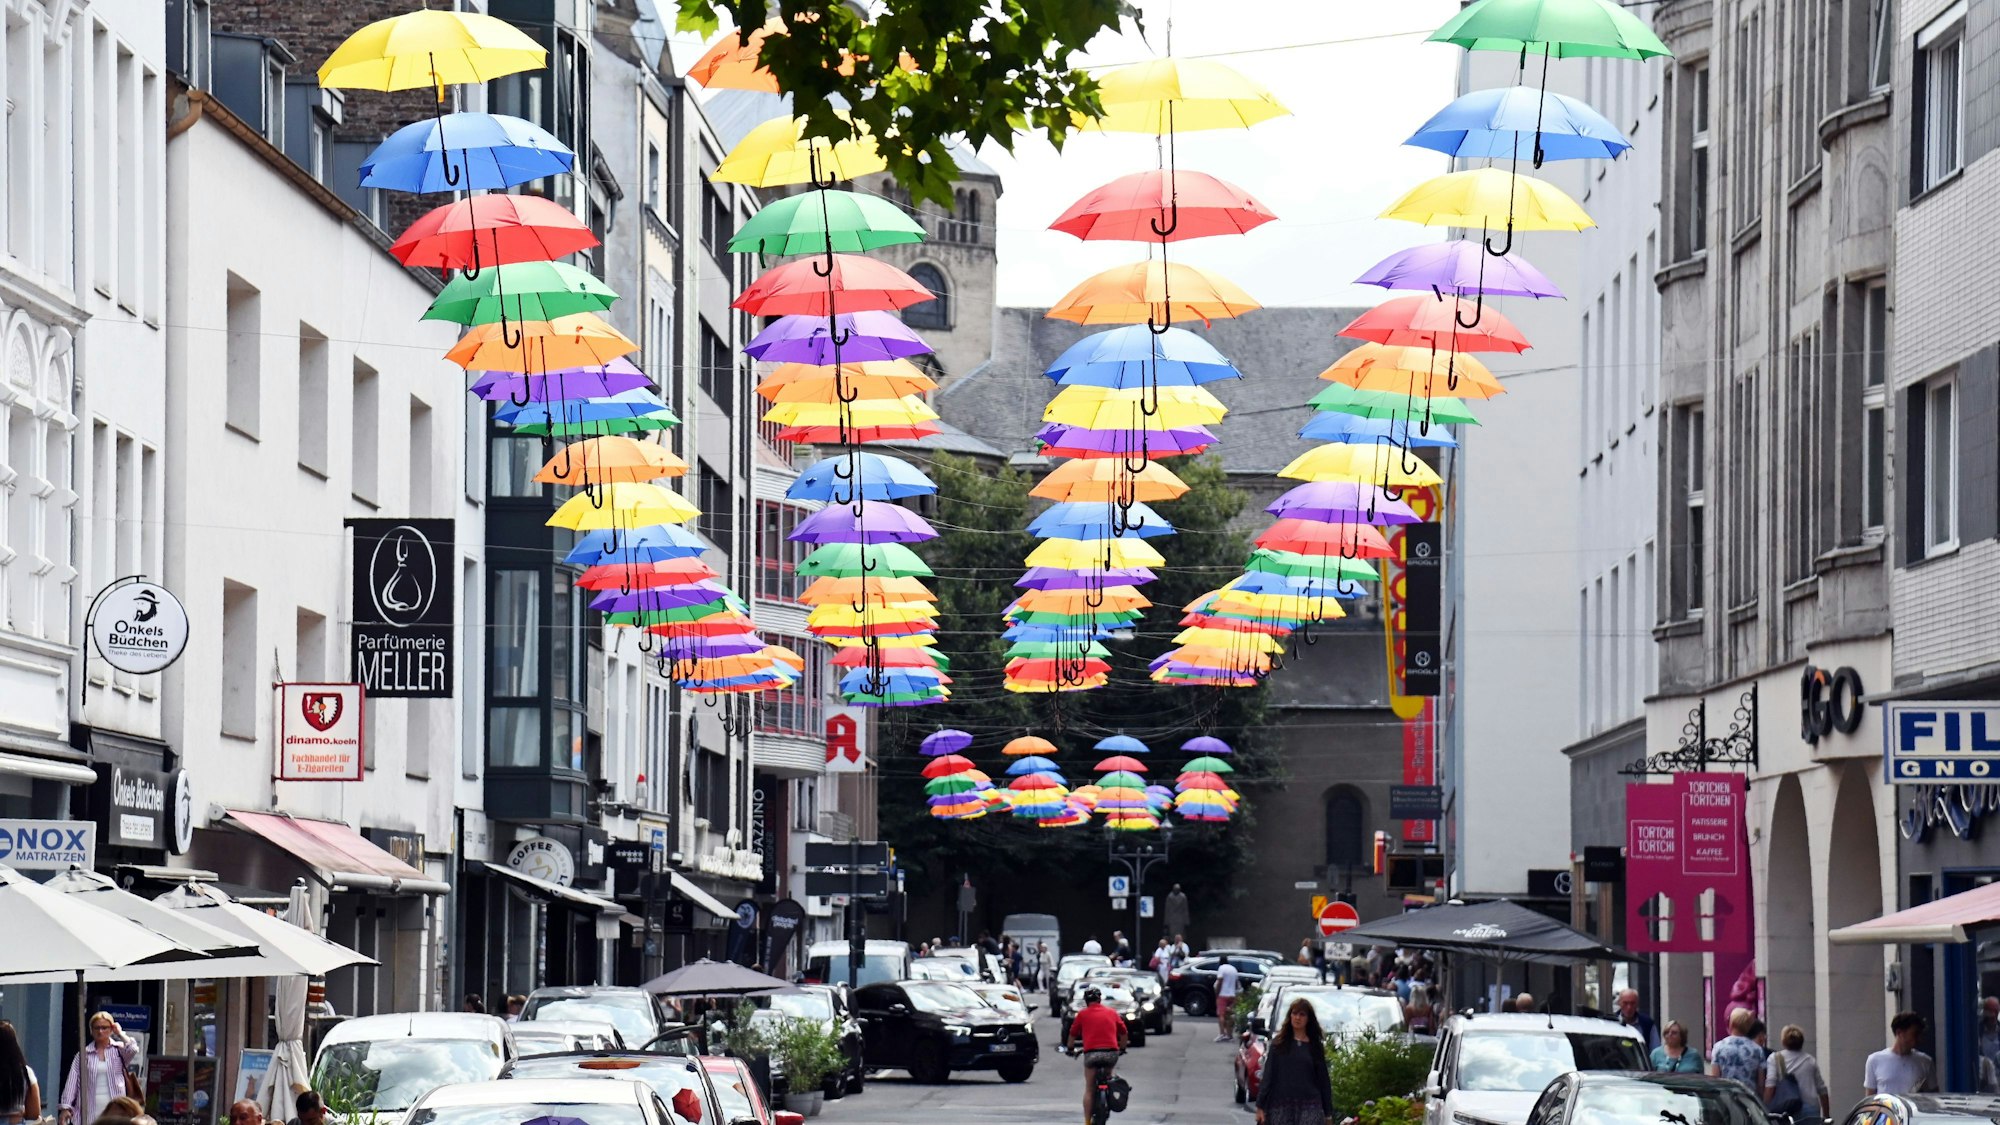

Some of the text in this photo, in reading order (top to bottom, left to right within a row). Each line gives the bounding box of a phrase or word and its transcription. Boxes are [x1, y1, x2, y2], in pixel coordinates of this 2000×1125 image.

[114, 620, 164, 636] Onkels
[109, 633, 168, 649] Büdchen
[358, 633, 446, 650] Parfümerie
[358, 651, 445, 691] MELLER
[286, 735, 357, 745] dinamo.koeln
[292, 753, 350, 763] Fachhandel für
[297, 764, 344, 773] E-Zigaretten
[114, 767, 164, 811] Onkels Büdchen
[1691, 818, 1728, 827] PATISSERIE
[17, 828, 86, 851] NOX
[1693, 833, 1725, 841] BRUNCH
[16, 851, 86, 862] MATRATZEN
[512, 842, 553, 866] COFFEE
[1696, 848, 1723, 856] KAFFEE
